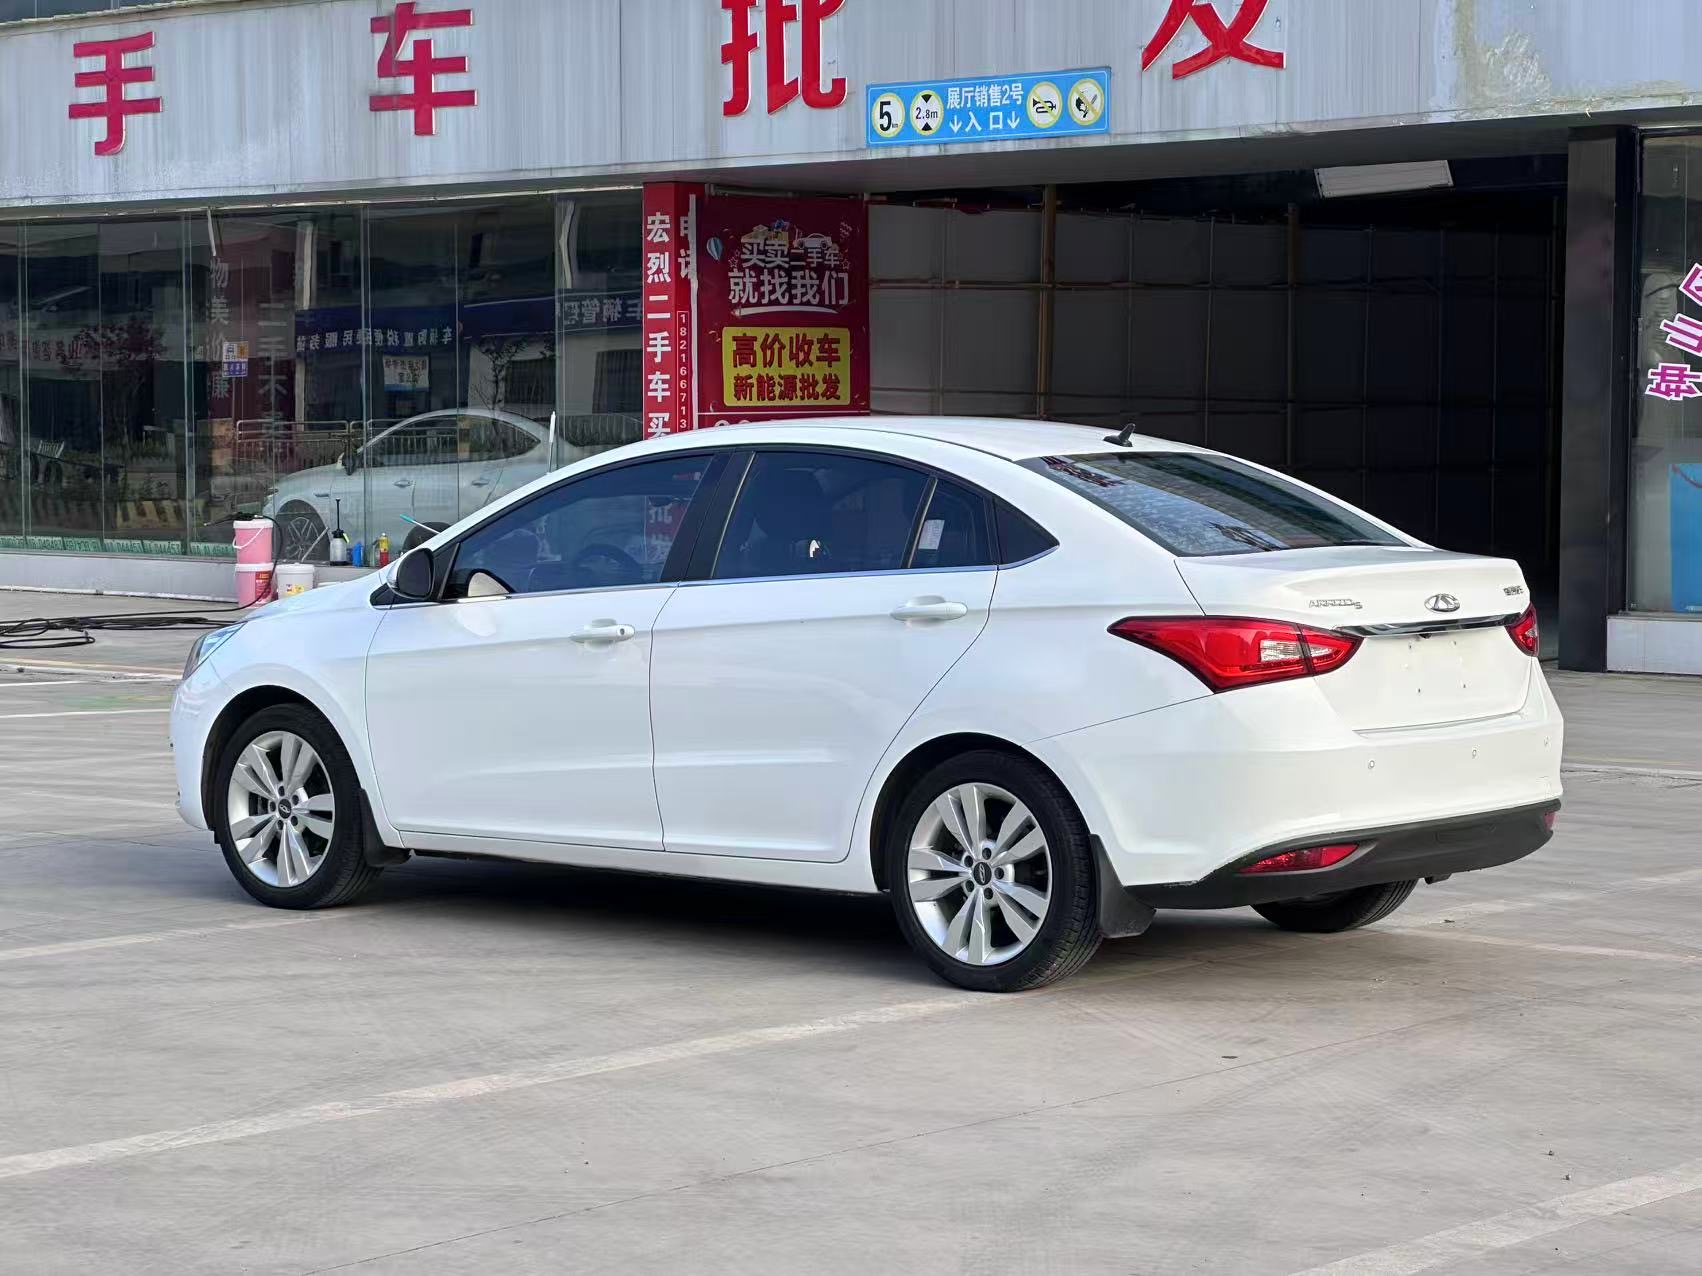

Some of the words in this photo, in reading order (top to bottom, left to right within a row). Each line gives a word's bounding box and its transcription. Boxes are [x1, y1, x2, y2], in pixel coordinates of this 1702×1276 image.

[946, 82, 1024, 109] 展厅销售2号
[915, 107, 939, 120] 2.8m
[964, 111, 1004, 132] 入口
[740, 240, 840, 268] 买卖二手车
[727, 268, 849, 306] 就找我们
[731, 332, 842, 369] 高价收车
[732, 372, 842, 402] 新能源批发
